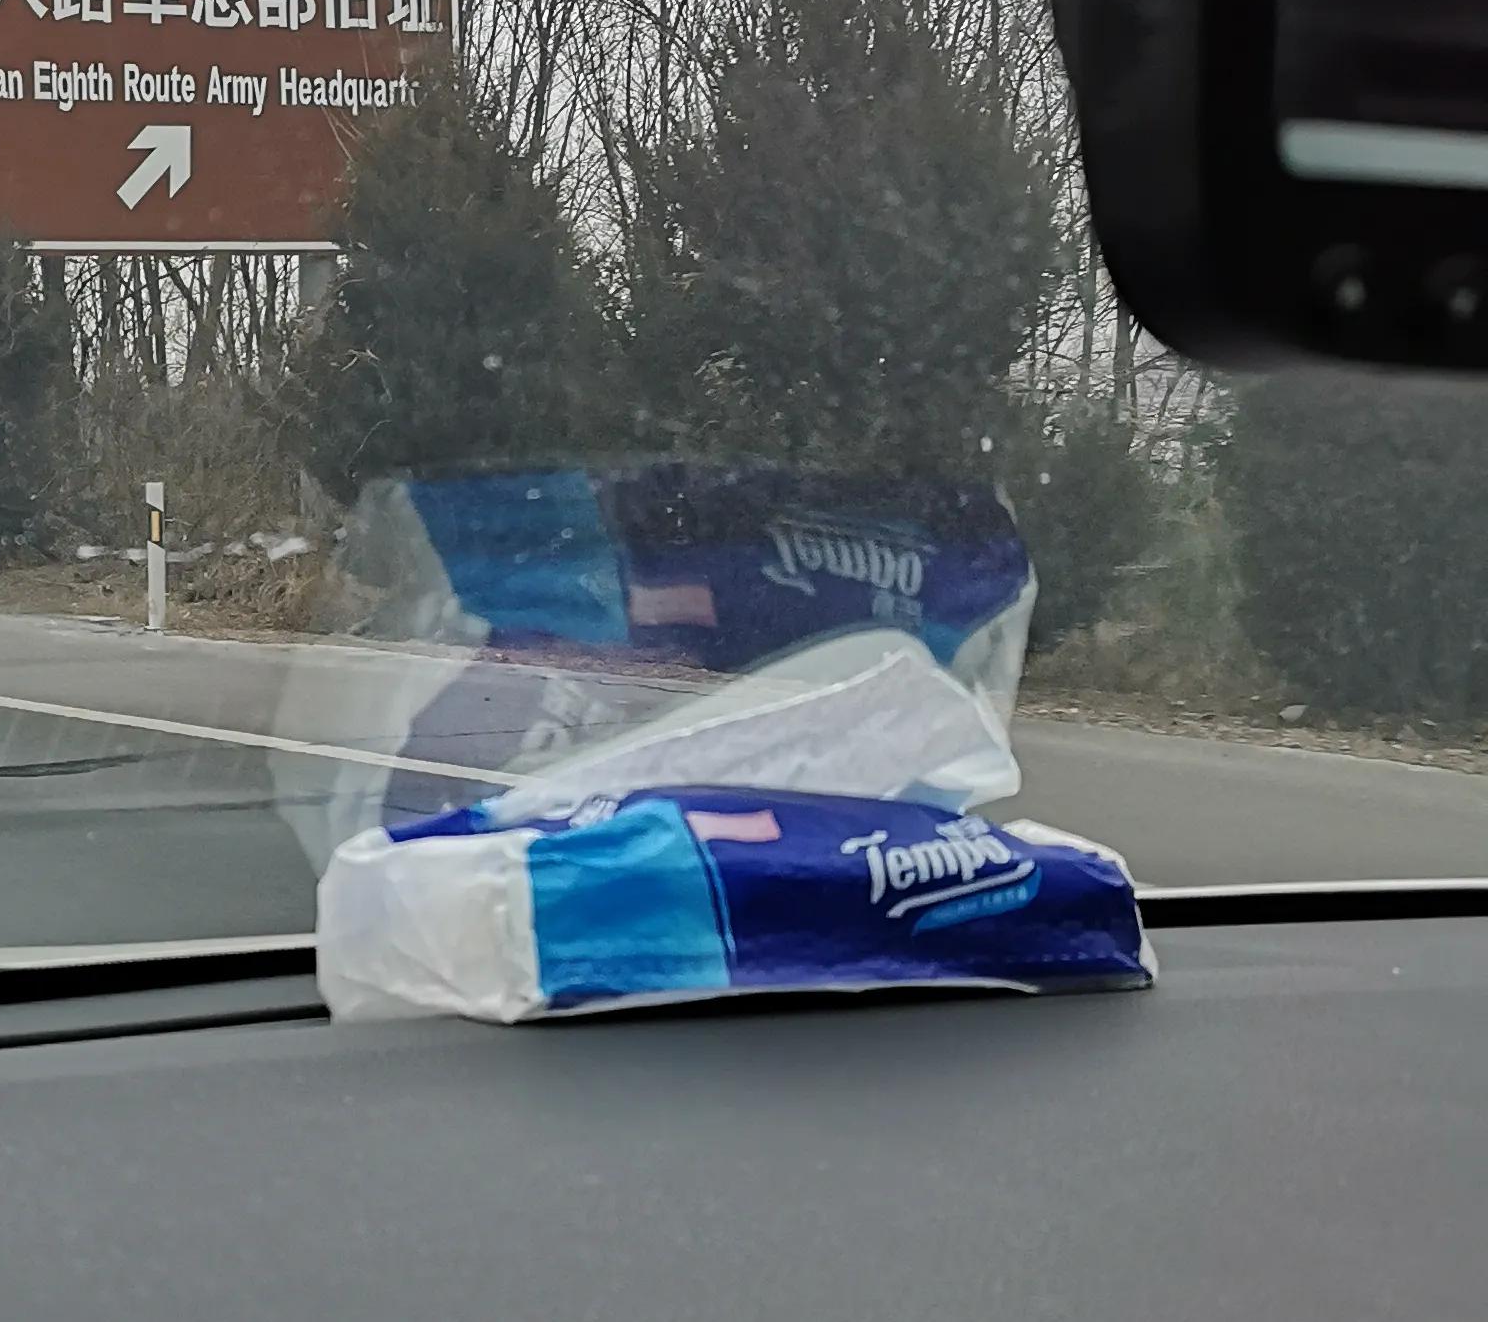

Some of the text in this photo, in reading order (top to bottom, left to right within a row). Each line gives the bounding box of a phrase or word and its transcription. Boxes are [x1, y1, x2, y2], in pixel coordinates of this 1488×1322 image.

[34, 61, 113, 111] Eighth
[123, 64, 195, 104] Route
[206, 65, 267, 116] Army
[840, 827, 1012, 905] Tempo
